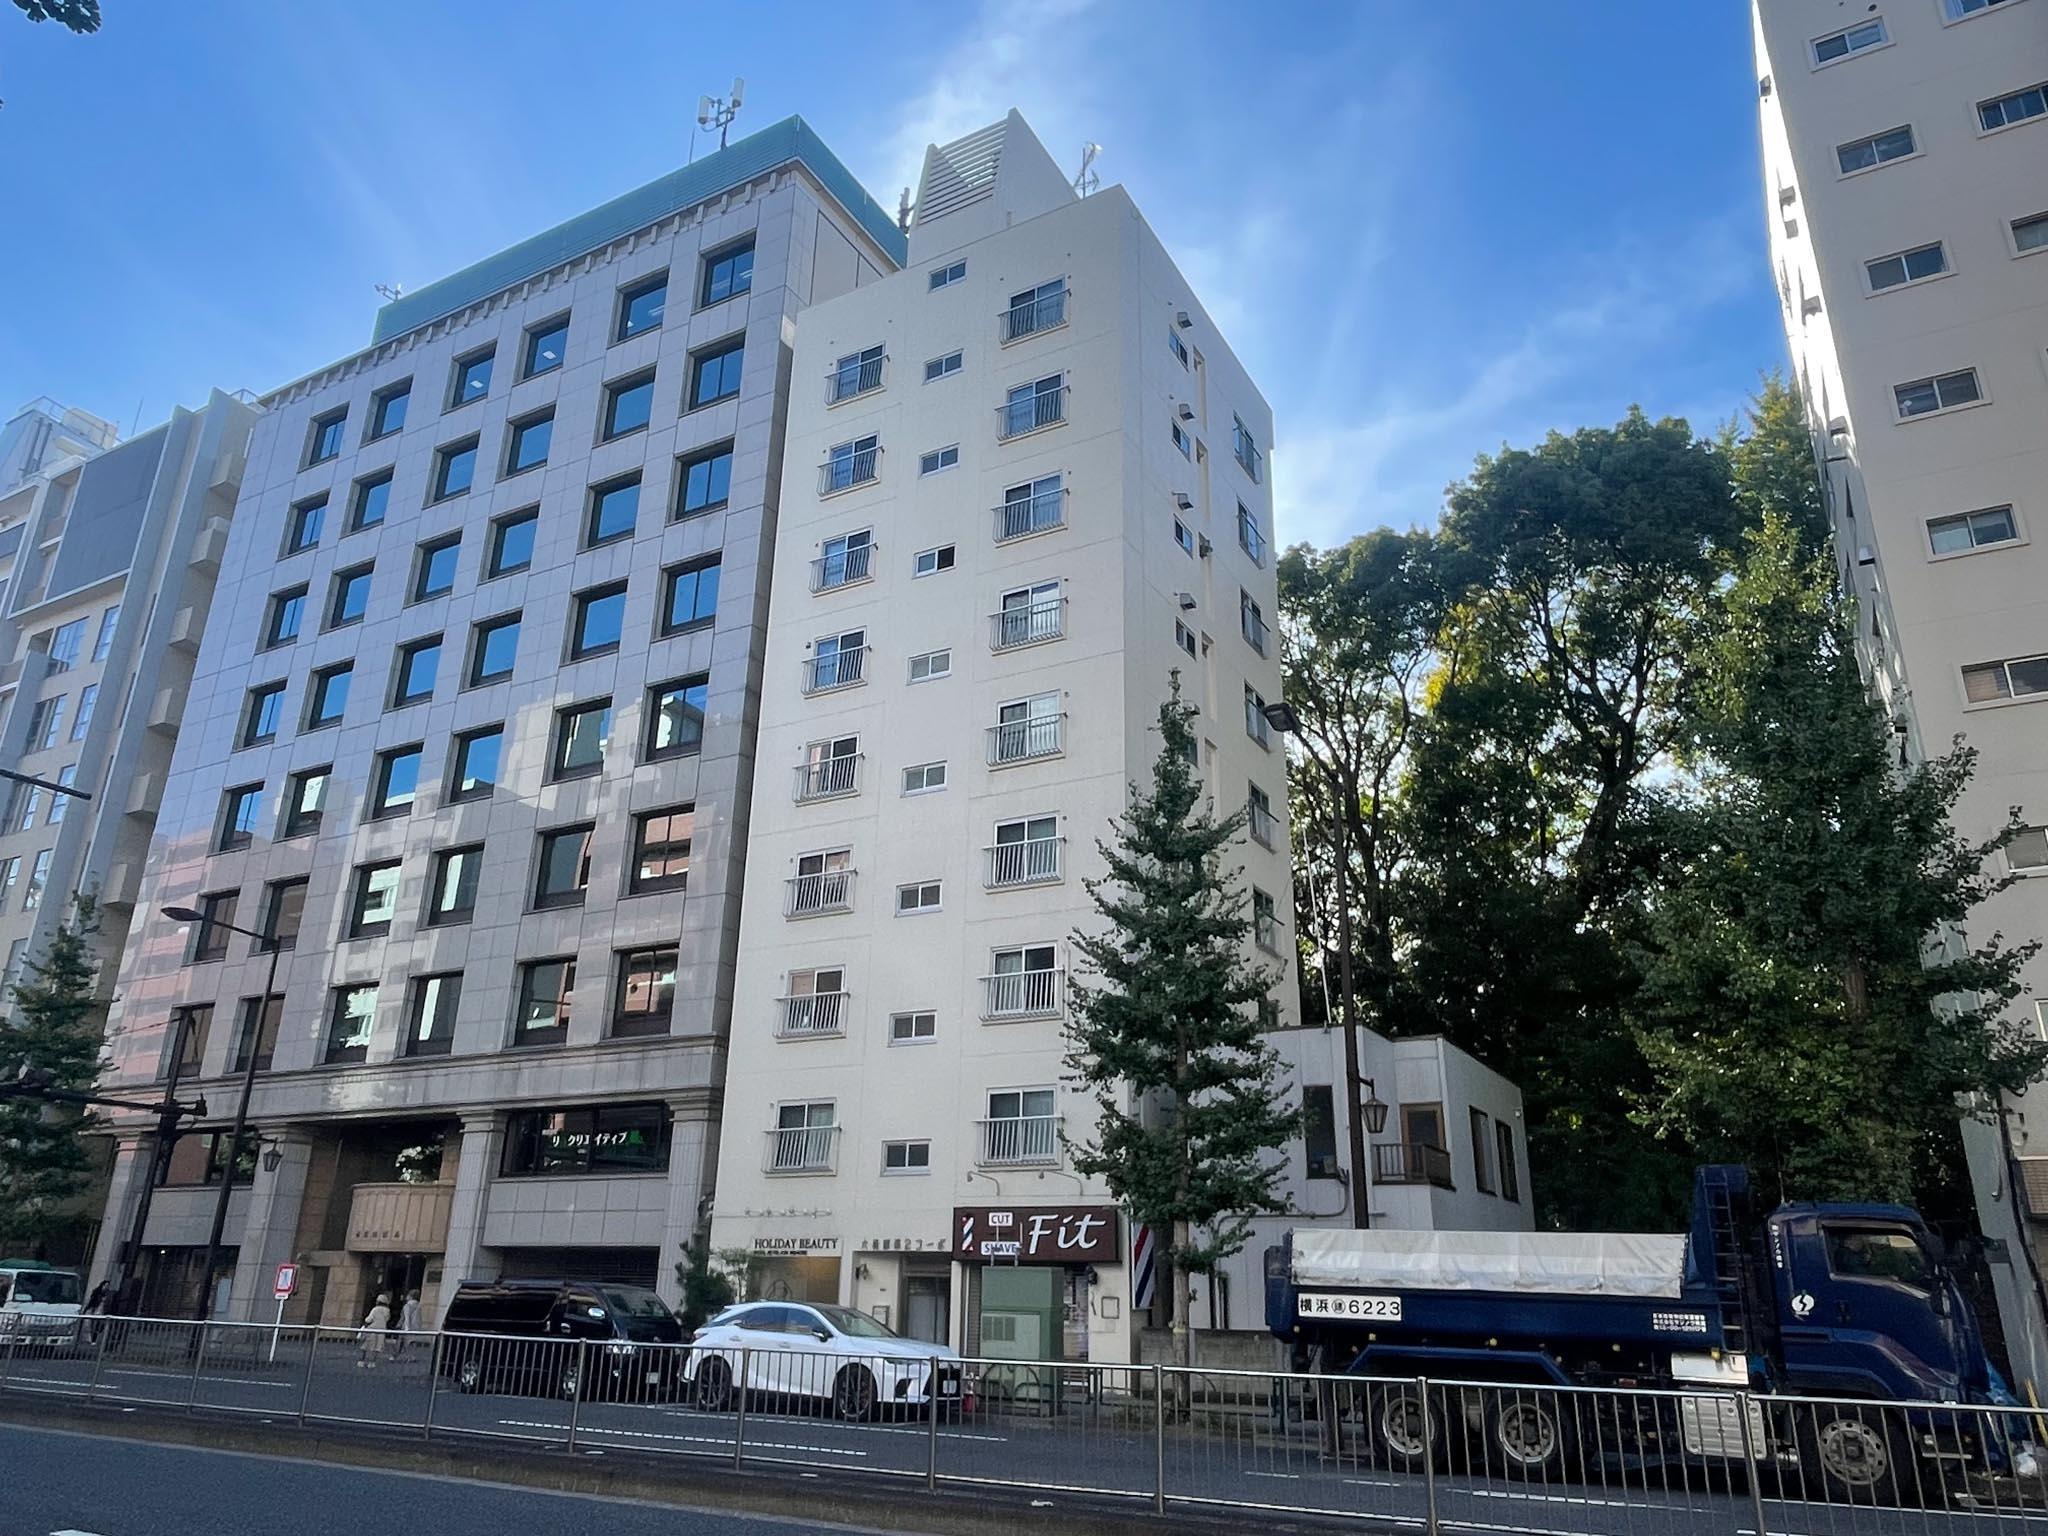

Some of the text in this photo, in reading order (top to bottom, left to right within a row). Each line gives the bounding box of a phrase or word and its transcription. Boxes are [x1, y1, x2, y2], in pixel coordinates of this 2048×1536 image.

[991, 1214, 1010, 1224] CUT
[1028, 1214, 1106, 1255] Fit
[754, 1238, 838, 1249] HOLIDAY BEAUTY
[984, 1243, 1017, 1254] SHAVE
[1348, 1300, 1400, 1316] 6223
